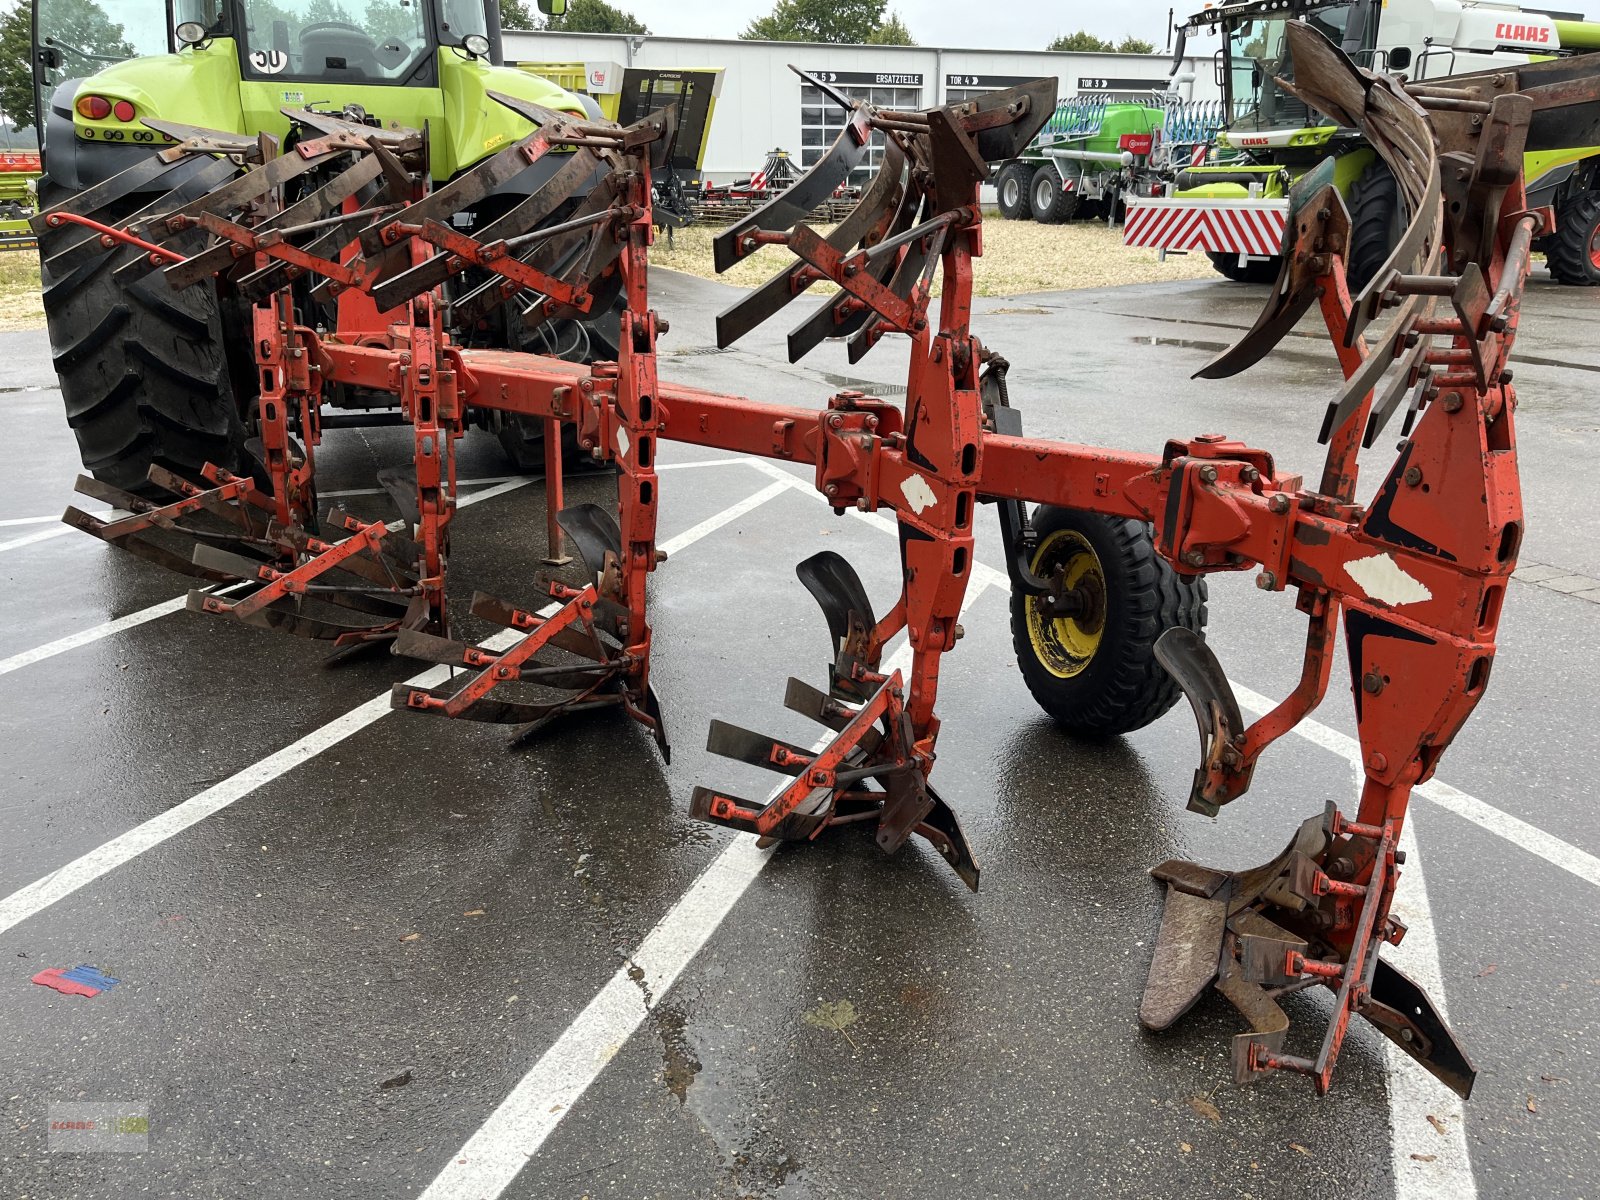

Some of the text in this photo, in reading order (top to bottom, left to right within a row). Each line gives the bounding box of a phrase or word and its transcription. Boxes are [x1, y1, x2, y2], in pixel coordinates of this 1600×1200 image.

[1225, 6, 1245, 14] LEXION
[1495, 23, 1549, 43] CLAAS
[876, 74, 919, 84] ERSATZTEILE
[950, 76, 970, 85] TOR 4
[1081, 79, 1099, 88] TOR 3
[1242, 138, 1269, 146] CLAAS
